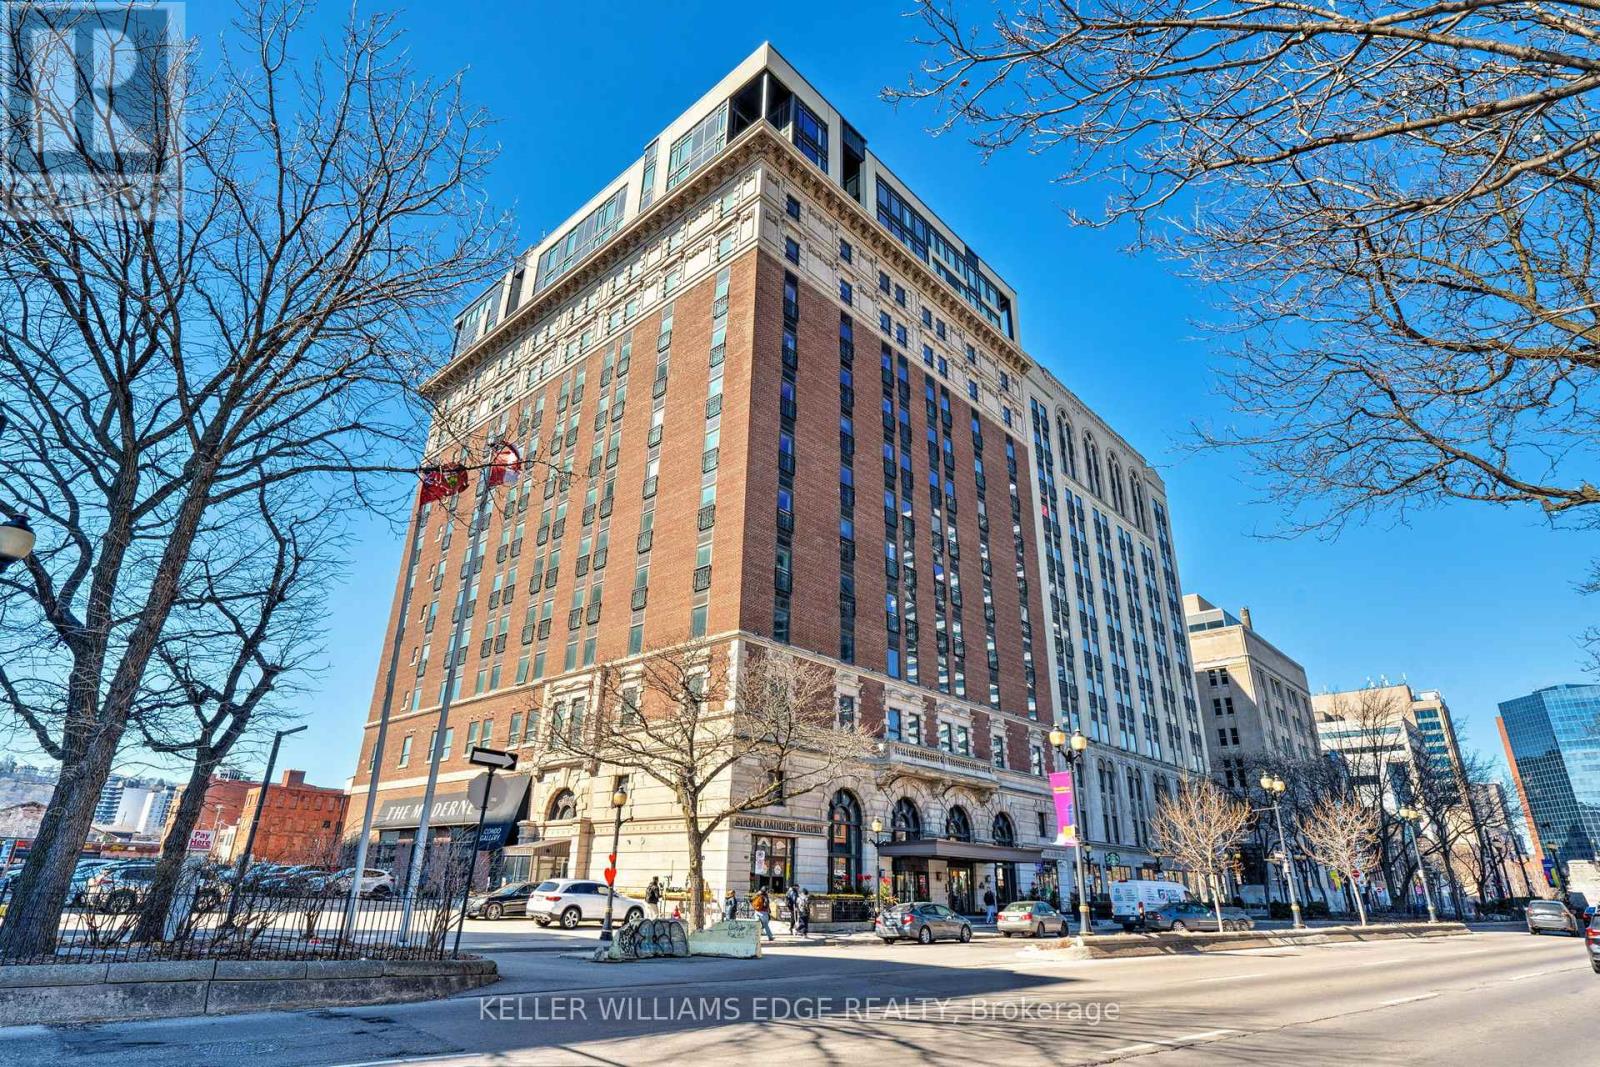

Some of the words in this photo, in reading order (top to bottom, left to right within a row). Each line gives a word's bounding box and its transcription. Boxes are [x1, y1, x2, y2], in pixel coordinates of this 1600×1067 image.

[386, 805, 411, 820] THE
[410, 799, 474, 818] MDERNE
[194, 831, 211, 840] Pay
[191, 838, 211, 847] Here
